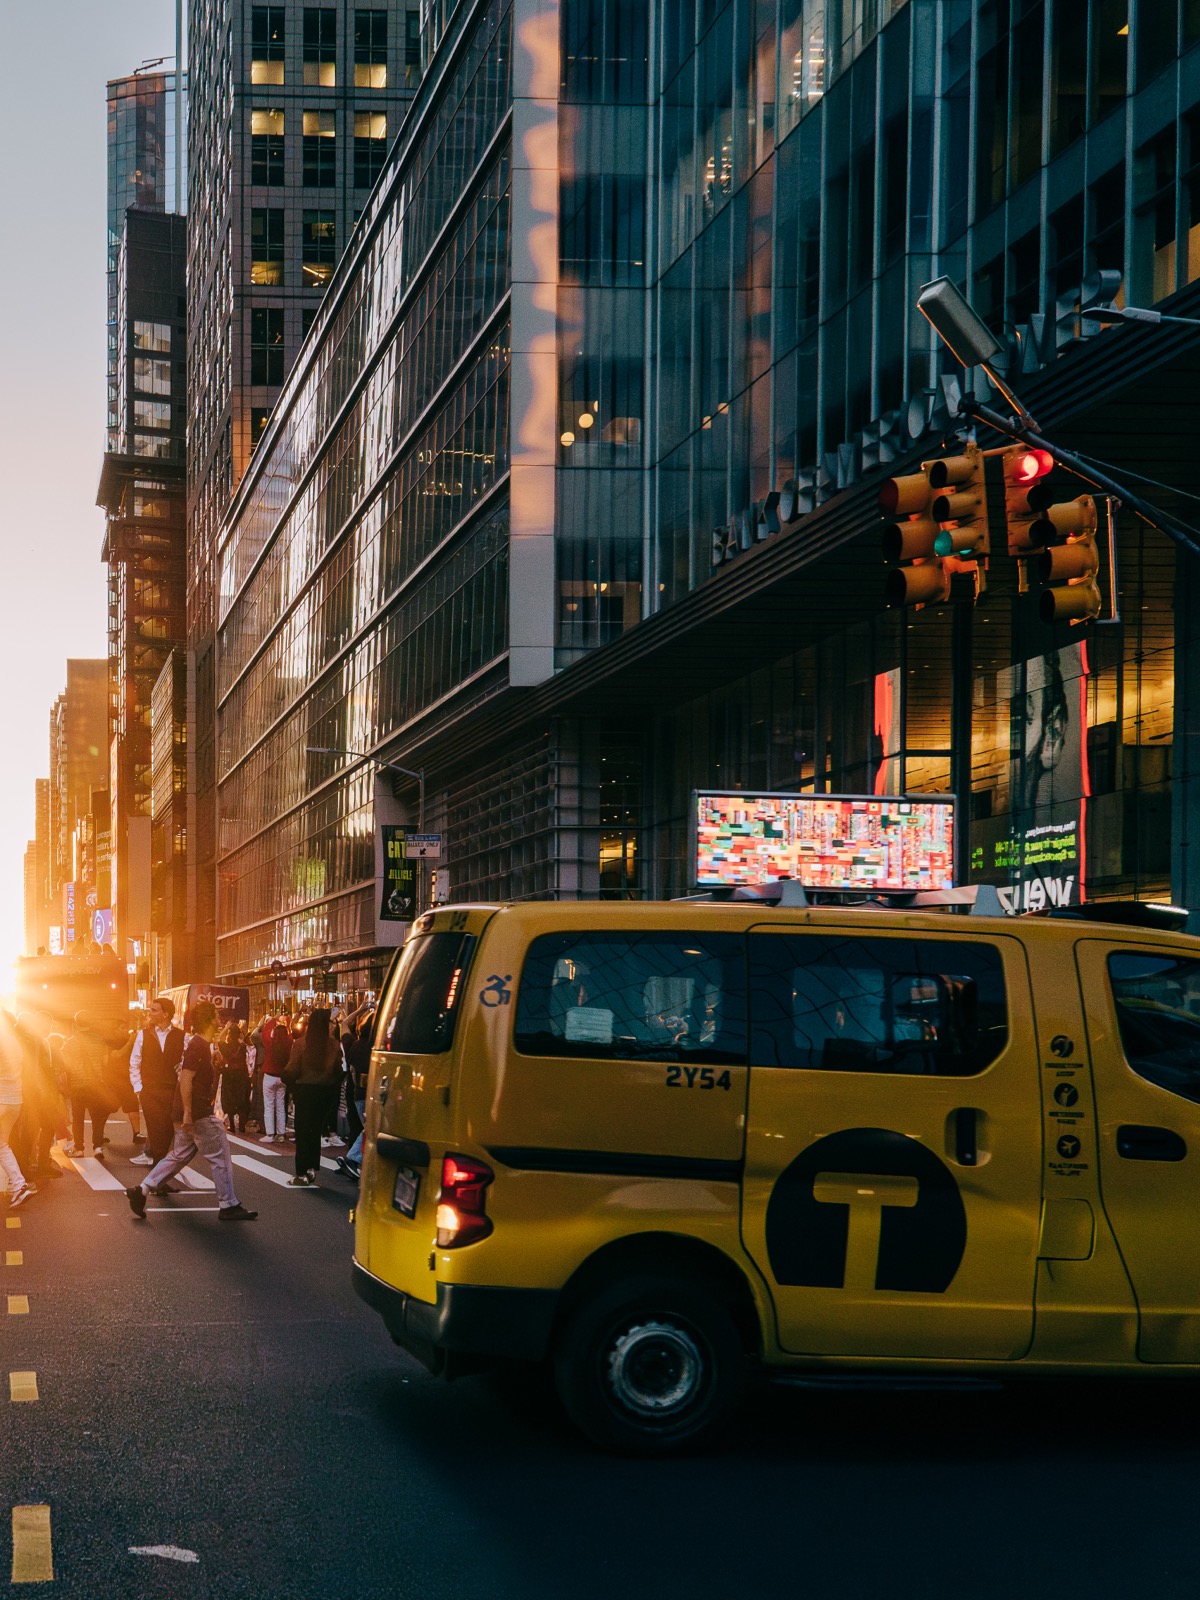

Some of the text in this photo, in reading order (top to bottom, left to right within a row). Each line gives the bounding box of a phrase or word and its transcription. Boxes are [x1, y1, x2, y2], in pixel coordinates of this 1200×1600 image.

[387, 841, 406, 858] CAT
[197, 992, 239, 1009] starr
[666, 1065, 731, 1091] 2Y54
